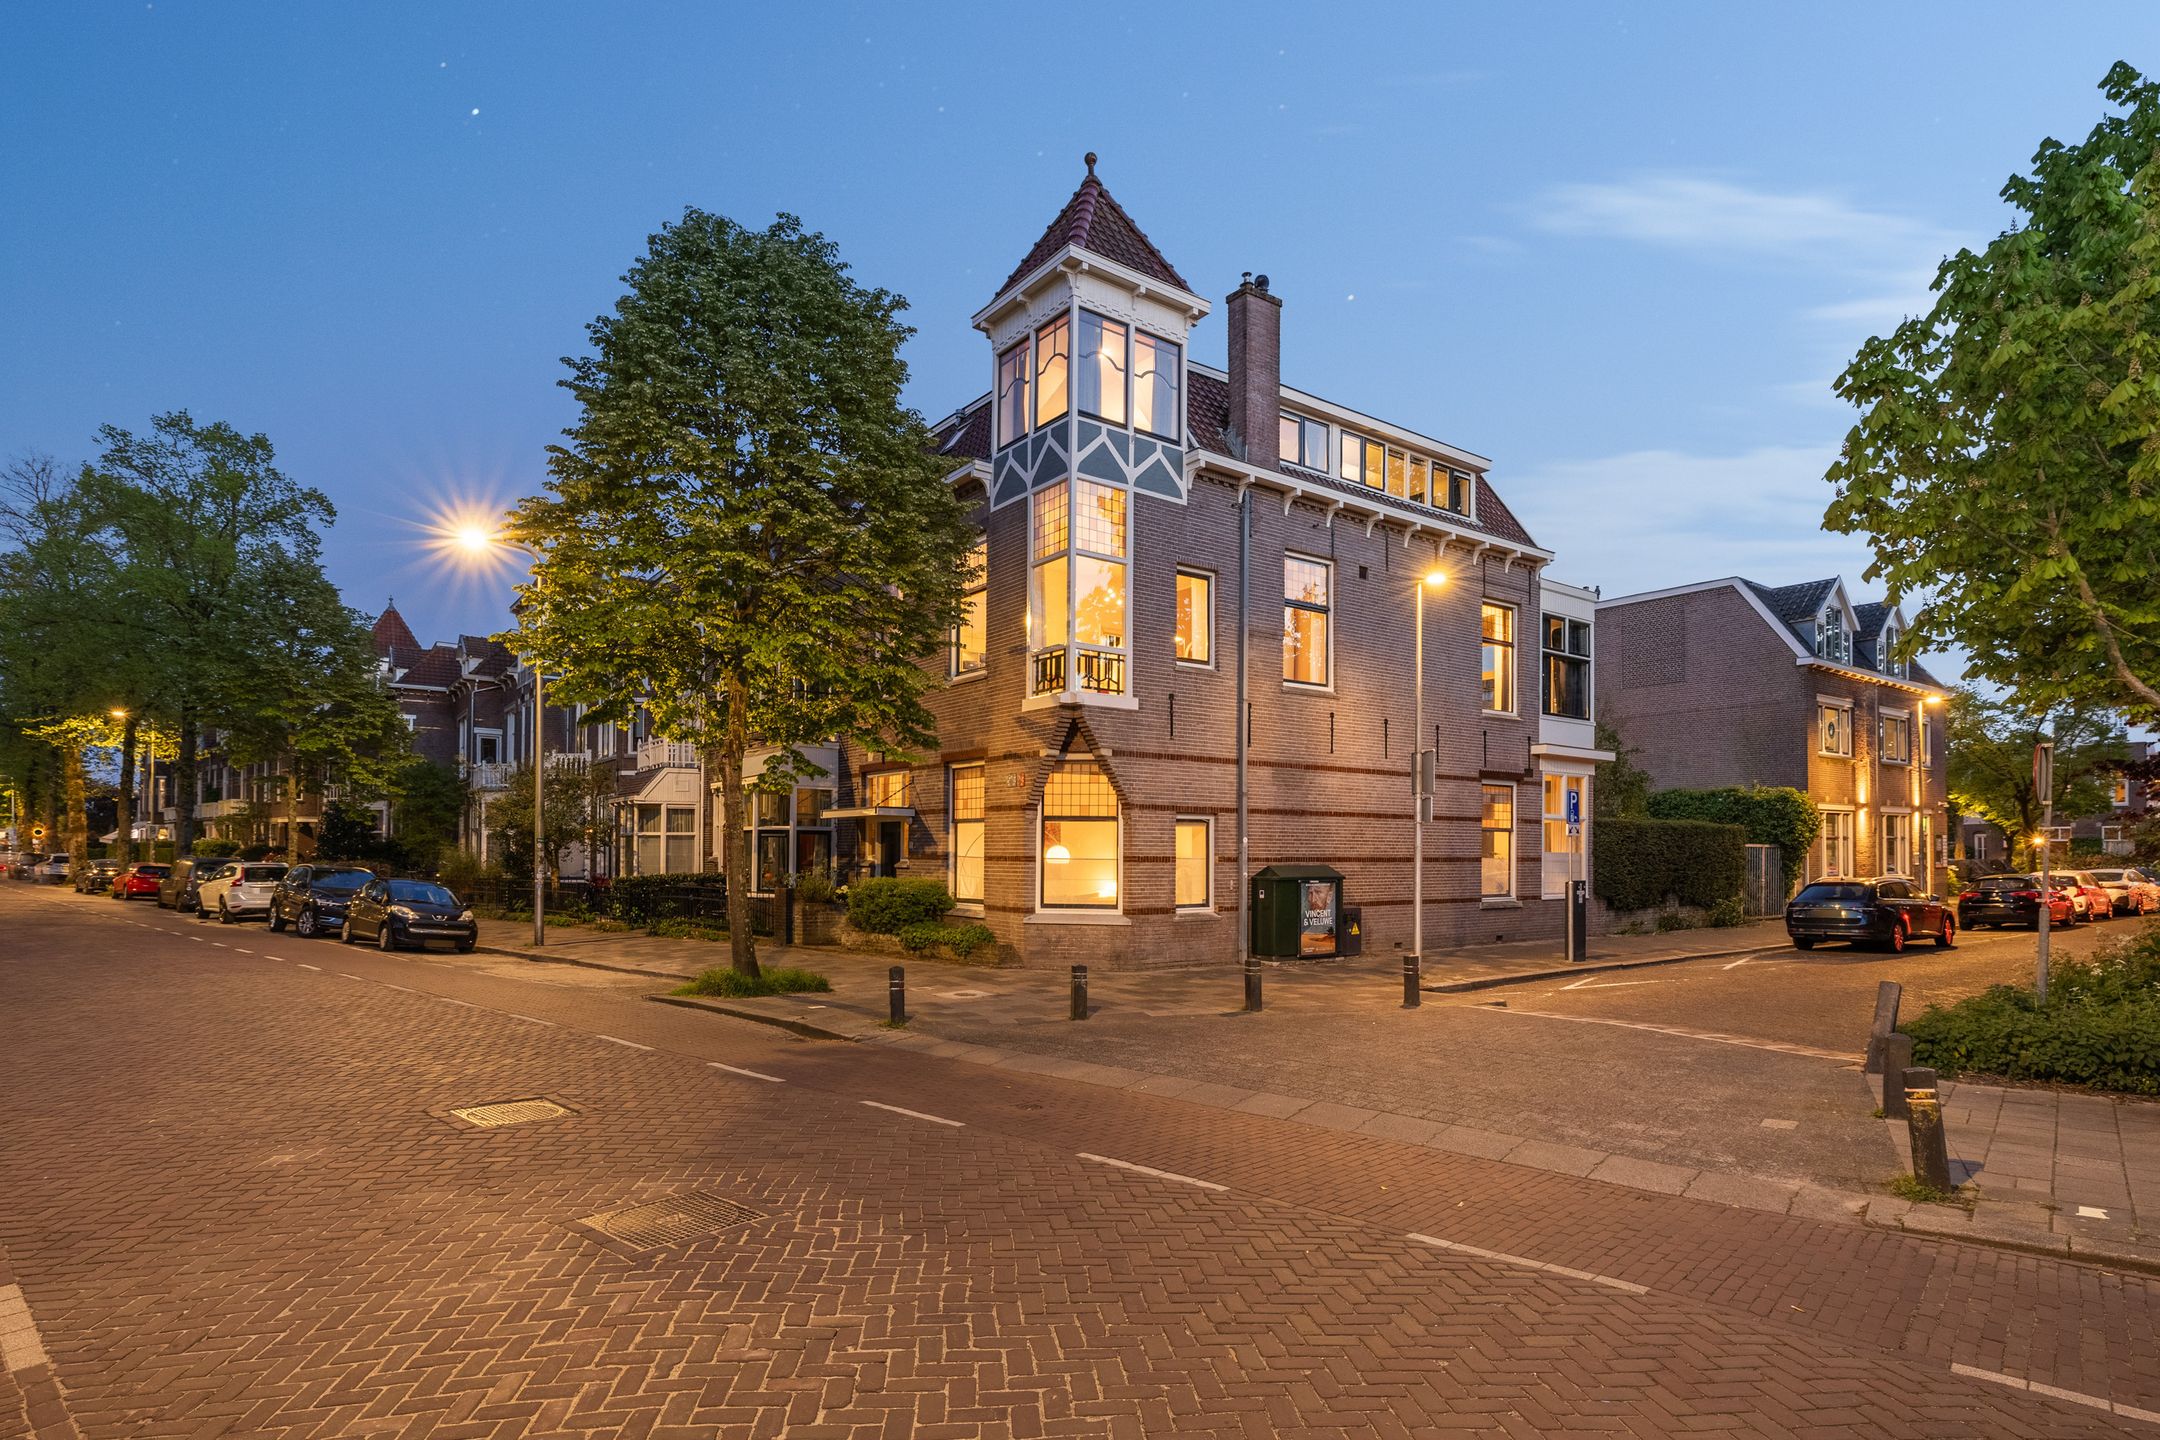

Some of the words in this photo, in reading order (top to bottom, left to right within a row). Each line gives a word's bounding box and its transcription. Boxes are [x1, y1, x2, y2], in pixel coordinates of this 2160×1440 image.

[1571, 792, 1577, 809] P
[1305, 910, 1331, 918] VINCENT
[1304, 918, 1308, 926] &
[1310, 918, 1332, 926] VELUWE
